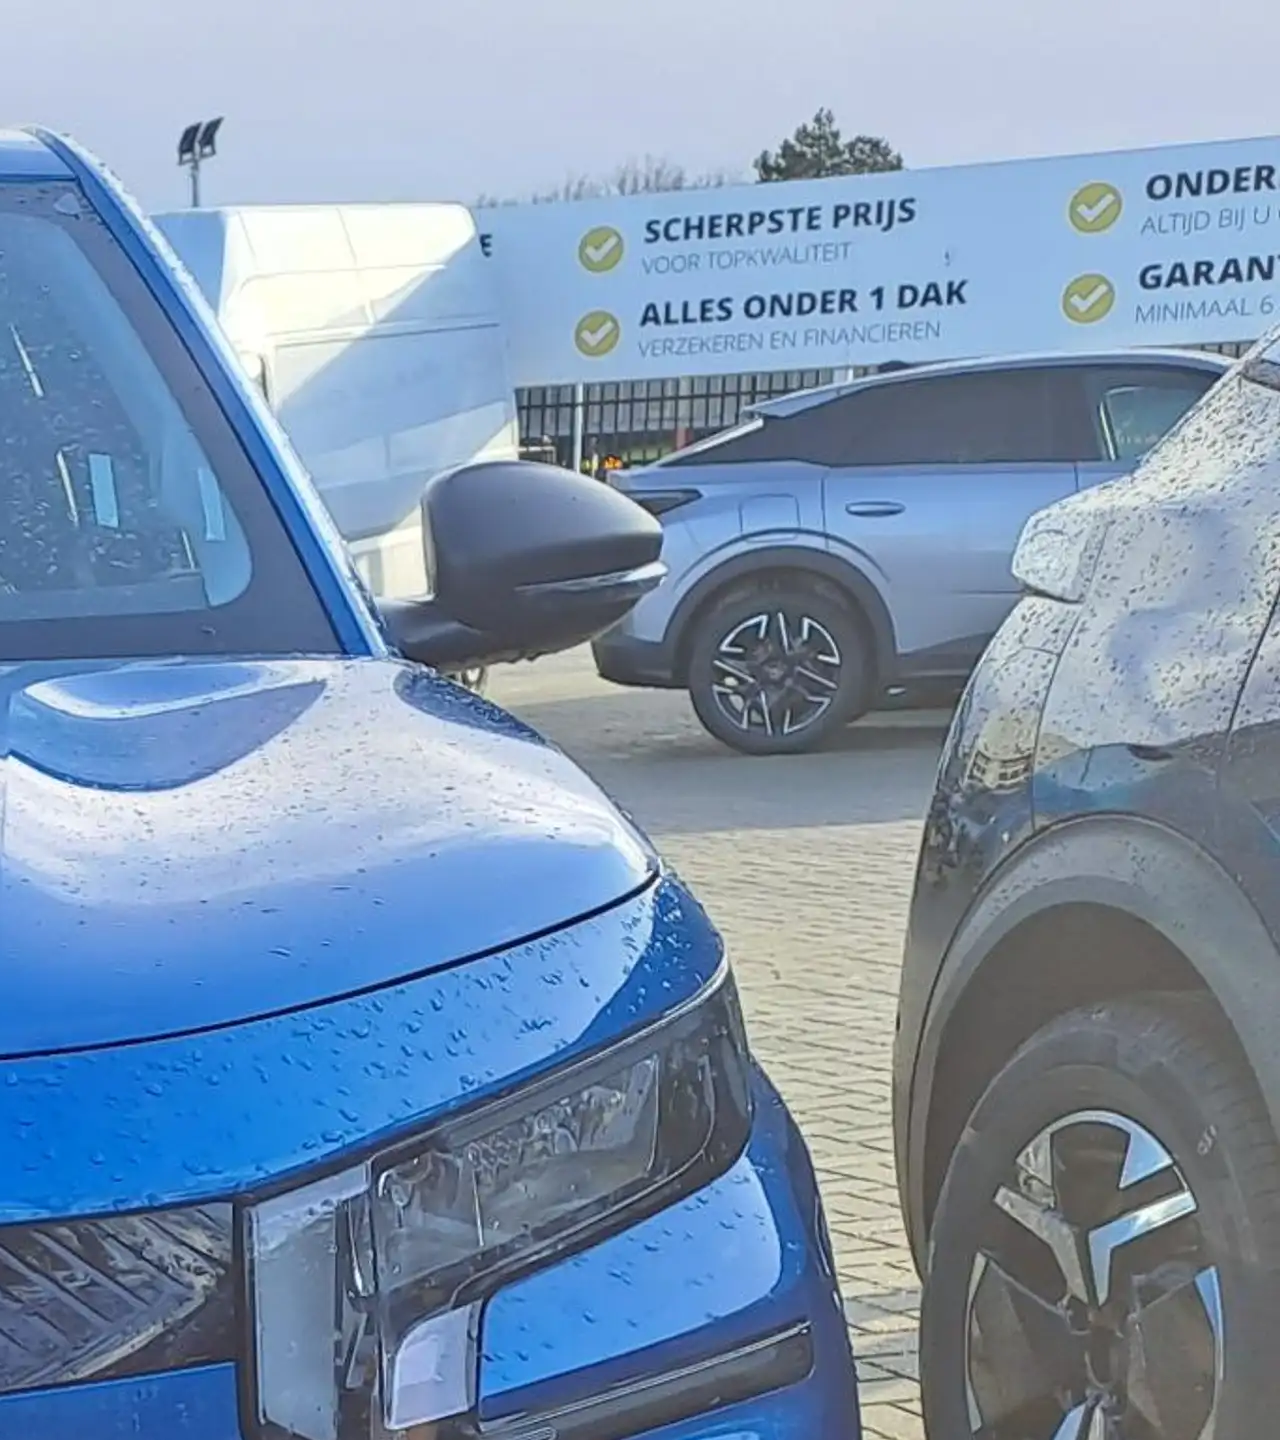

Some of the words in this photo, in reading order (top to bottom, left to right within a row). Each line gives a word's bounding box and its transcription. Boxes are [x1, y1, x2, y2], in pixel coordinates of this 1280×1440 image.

[644, 205, 822, 243] SCHERPSTE
[832, 198, 916, 232] PRIJS
[1140, 210, 1211, 236] ALTIJD
[1218, 206, 1246, 231] BIJ
[1253, 206, 1271, 225] U
[641, 252, 699, 275] VOOR
[708, 241, 852, 271] TOPKWALITEIT
[1139, 254, 1280, 290] GARAN
[639, 297, 734, 327] ALLES
[743, 288, 858, 319] ONDER
[869, 286, 885, 310] 1
[897, 279, 969, 309] DAK
[1135, 297, 1253, 324] MINIMAAL
[1260, 294, 1275, 315] 6
[637, 331, 765, 359] VERZEKEREN
[770, 329, 797, 350] EN
[804, 321, 942, 347] FINANCIEREN
